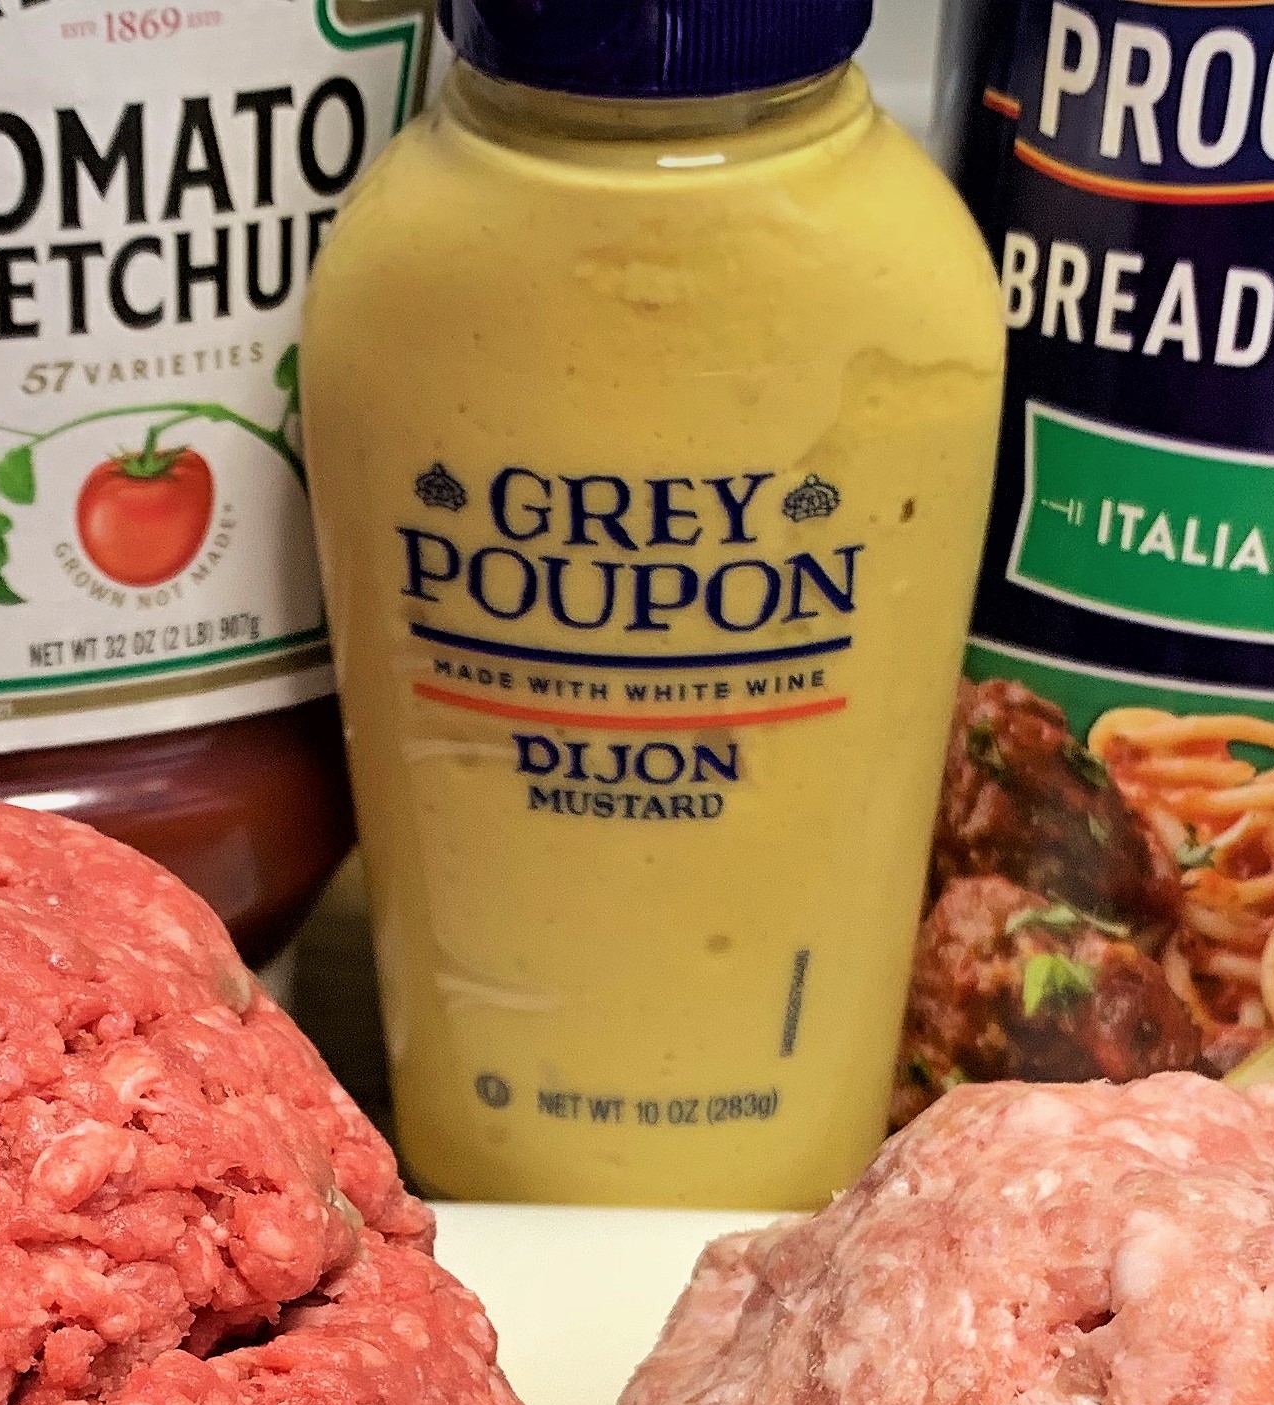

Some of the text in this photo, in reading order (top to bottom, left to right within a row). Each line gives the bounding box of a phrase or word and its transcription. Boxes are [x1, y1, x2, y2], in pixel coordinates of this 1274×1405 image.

[103, 8, 184, 43] 1869
[20, 341, 265, 396] 57 VARIETIES
[488, 467, 775, 552] GREY
[53, 541, 125, 609] GROWN
[136, 583, 184, 611] NOT
[395, 526, 866, 634] POUPON
[29, 641, 65, 668] NET
[71, 637, 98, 664] WT
[104, 634, 126, 660] 32
[133, 630, 157, 656] OZ
[432, 659, 827, 702] MADE WITH WHITE WINE
[511, 732, 740, 786] DIJON
[526, 785, 725, 820] MUSTARD
[536, 1085, 782, 1127] NET WT 10 OZ (283g)
